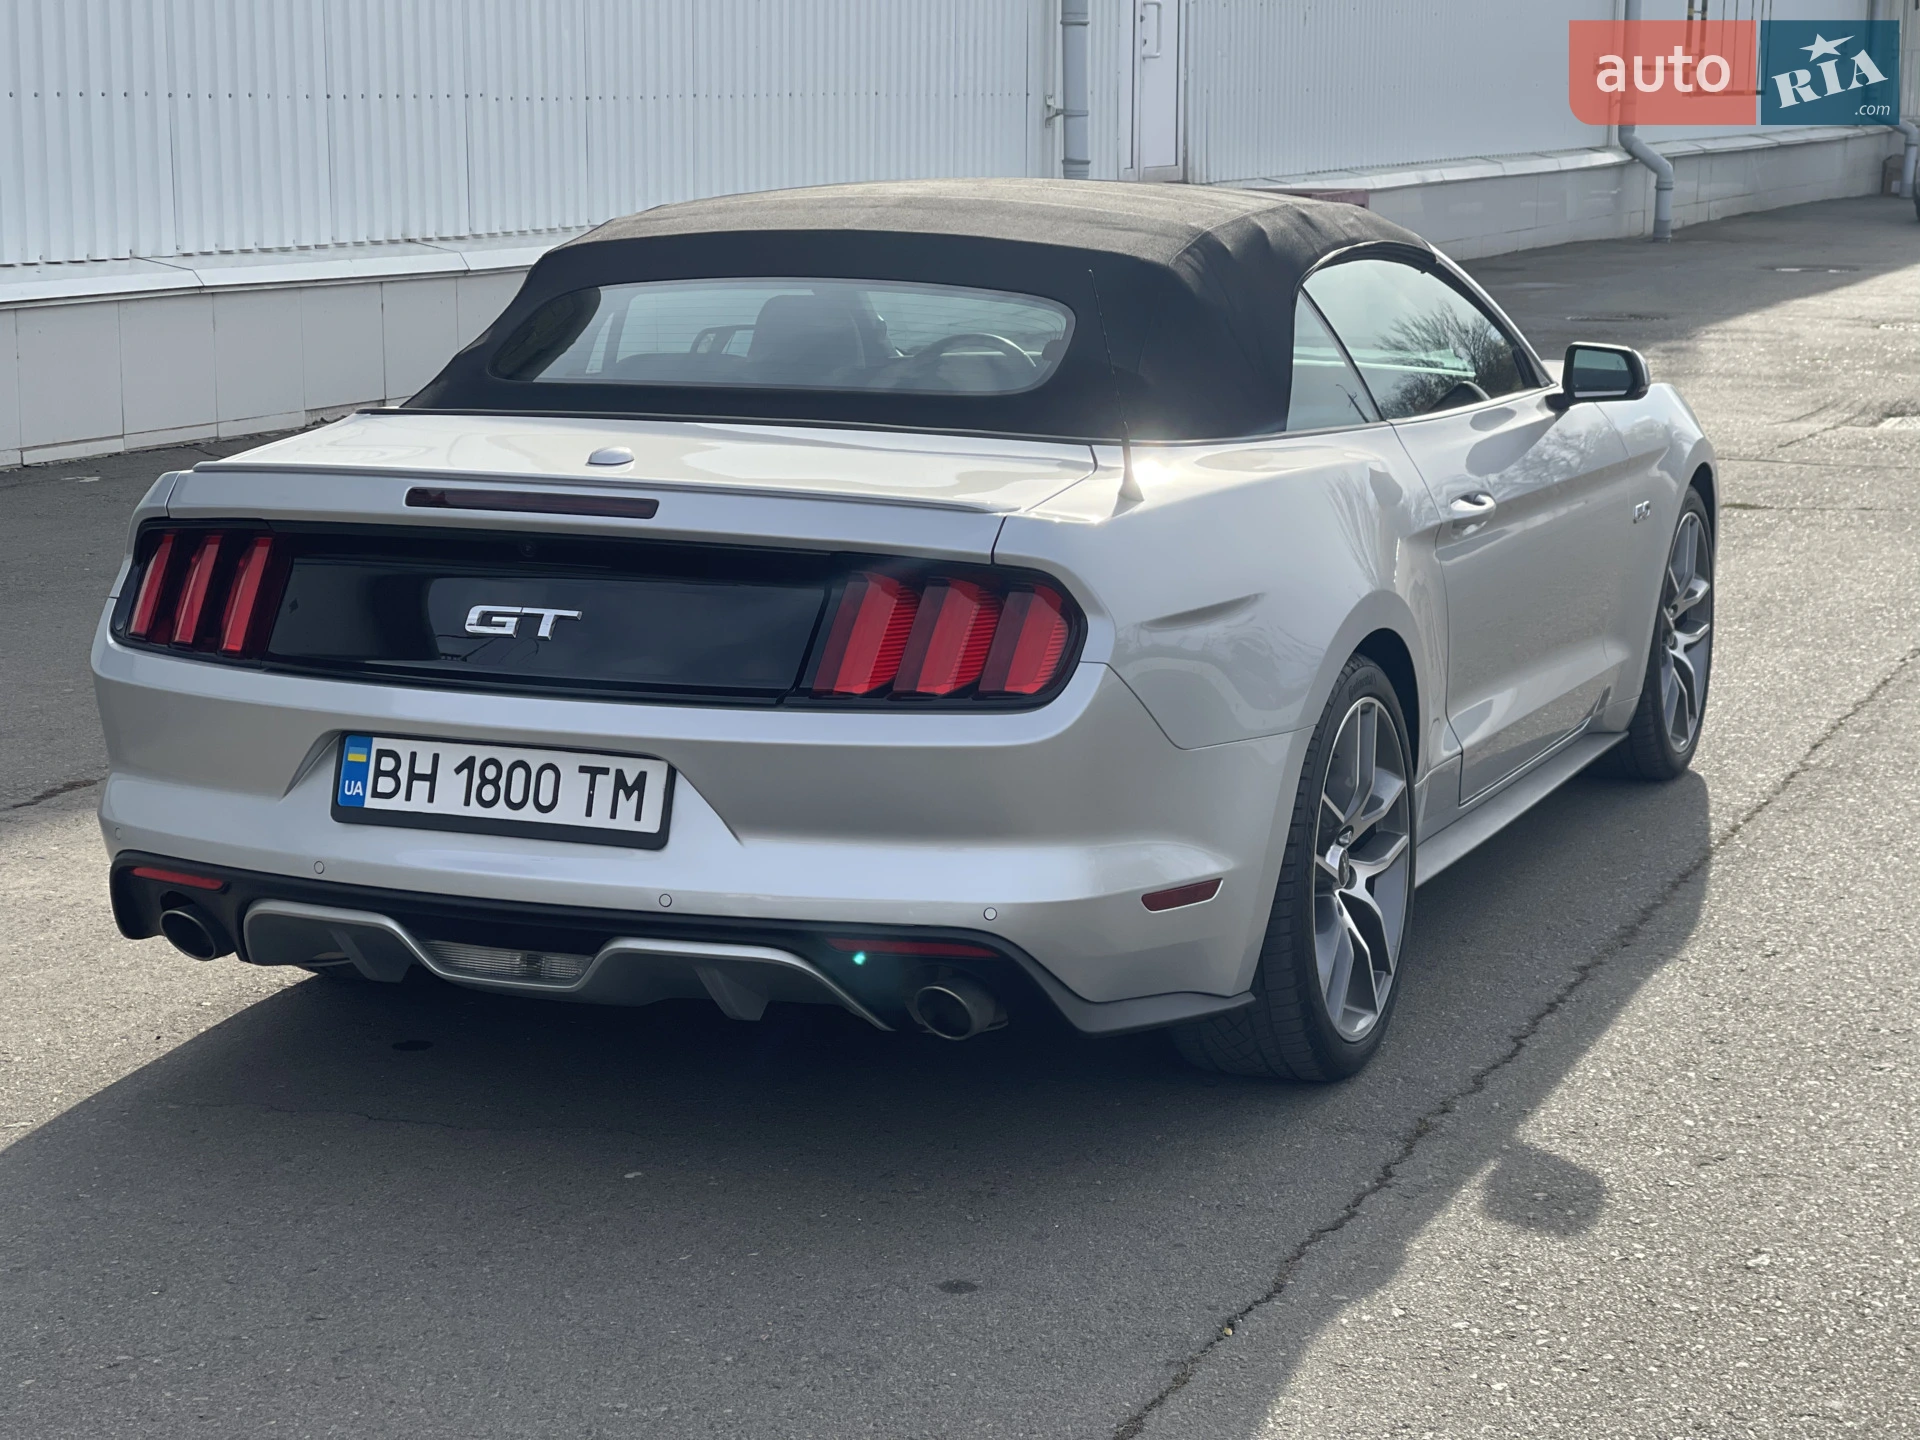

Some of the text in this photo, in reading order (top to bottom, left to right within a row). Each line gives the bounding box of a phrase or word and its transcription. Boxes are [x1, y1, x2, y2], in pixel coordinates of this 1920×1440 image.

[465, 605, 582, 640] GT
[344, 780, 363, 796] UA
[370, 749, 647, 822] BH 1800 TM
